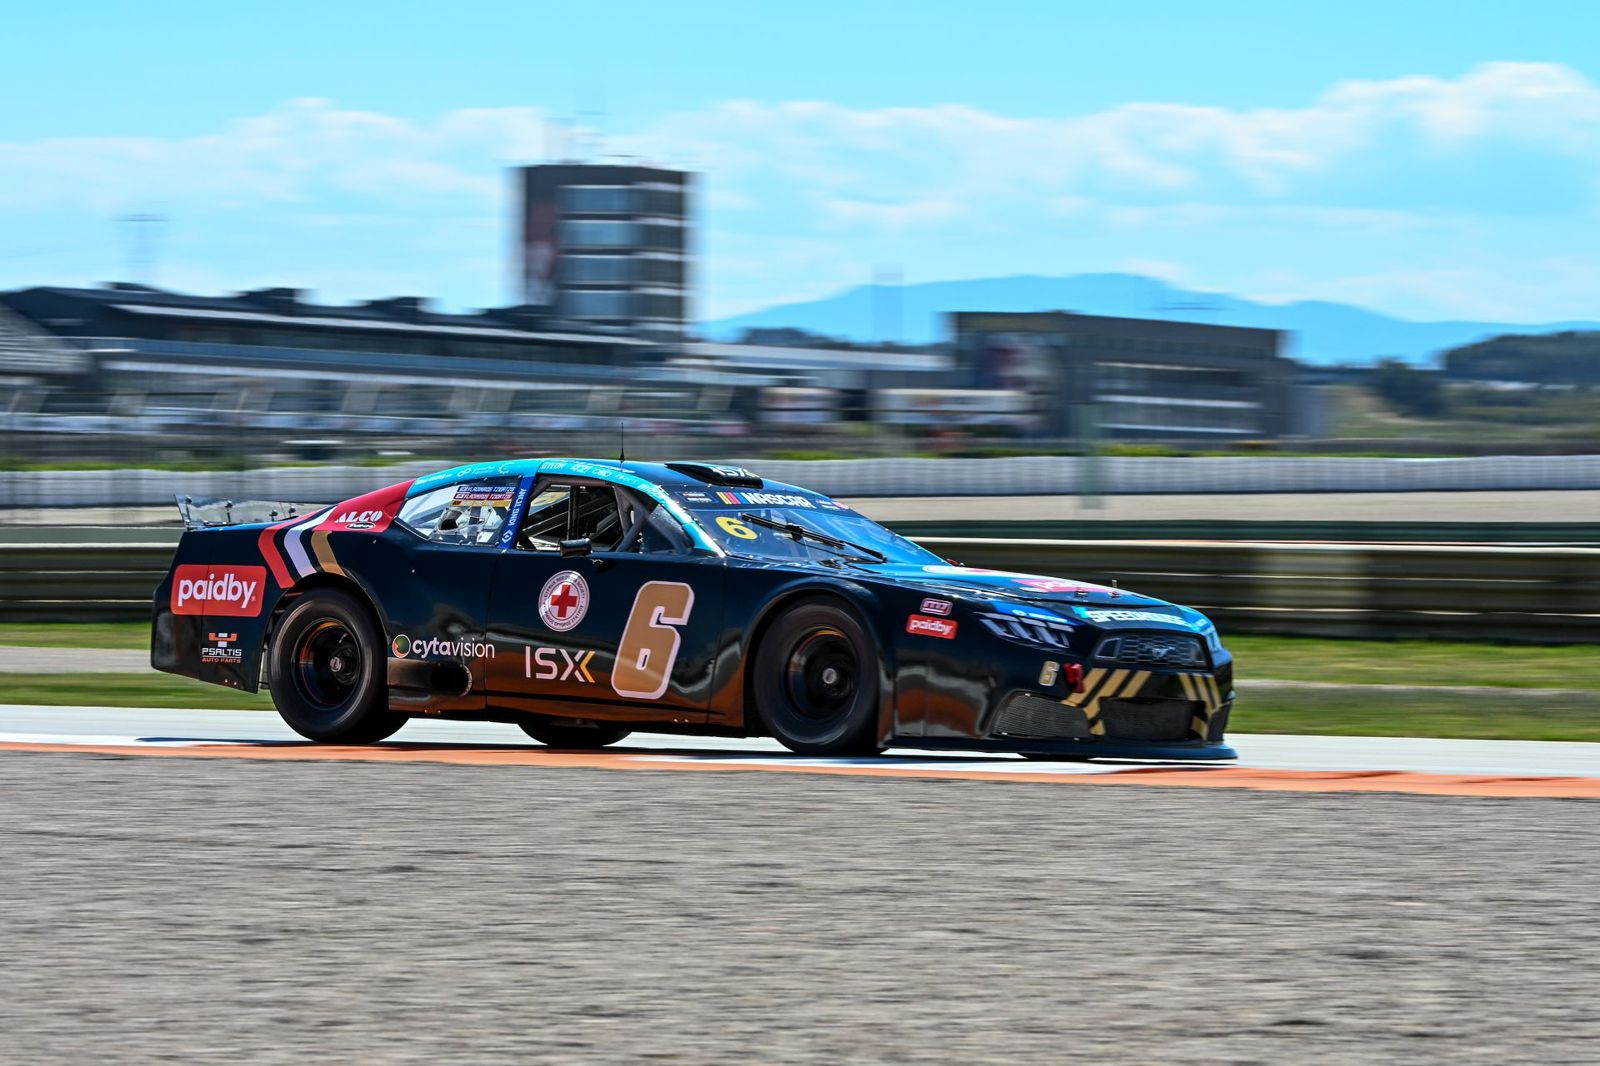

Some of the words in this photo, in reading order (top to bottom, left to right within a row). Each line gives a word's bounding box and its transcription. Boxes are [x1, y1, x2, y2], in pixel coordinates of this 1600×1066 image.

[515, 488, 527, 508] TONY
[742, 492, 817, 509] NASCAR
[334, 510, 383, 523] ALCO
[715, 516, 758, 540] 6
[177, 573, 257, 609] paidby
[911, 619, 953, 636] paidby
[411, 637, 495, 659] cytavision
[611, 580, 694, 699] 6
[201, 648, 242, 657] PSALTIS
[1039, 661, 1060, 686] 6
